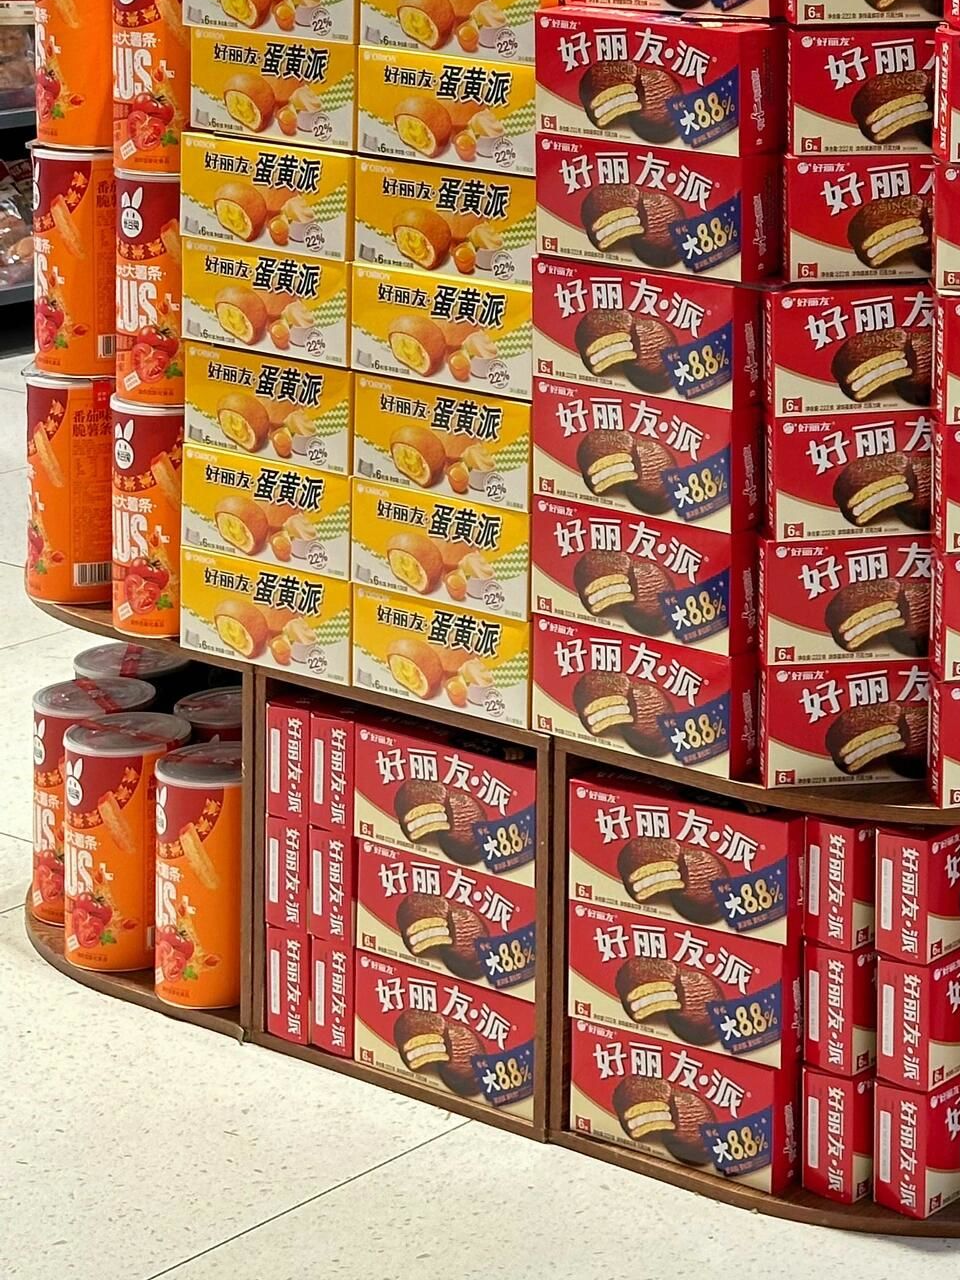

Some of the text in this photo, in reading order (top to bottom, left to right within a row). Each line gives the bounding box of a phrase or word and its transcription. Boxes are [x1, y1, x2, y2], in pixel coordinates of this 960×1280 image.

[558, 28, 710, 86] 好丽友·派
[559, 152, 713, 212] 好丽友·派
[554, 277, 705, 339] 好丽友·派
[805, 291, 933, 350] 好丽友
[555, 397, 703, 462] 好丽友·派
[553, 517, 702, 584] 好丽友·派
[798, 542, 930, 599] 好丽友
[554, 633, 702, 707] 好丽友·派
[799, 666, 929, 722] 好丽友
[287, 718, 303, 812] 好丽友·派
[330, 729, 347, 824] 好丽友·派
[375, 748, 512, 817] 好丽友·派
[595, 804, 758, 872] 好丽友·派
[378, 861, 514, 933] 好丽友·派
[828, 835, 846, 938] 好丽友·派
[901, 847, 919, 953] 好丽友·派
[287, 940, 301, 1034] 好丽友·派
[593, 924, 753, 995] 好丽友·派
[375, 975, 511, 1051] 好丽友·派
[903, 974, 921, 1080] 好丽友·派
[593, 1042, 745, 1119] 好丽友·派
